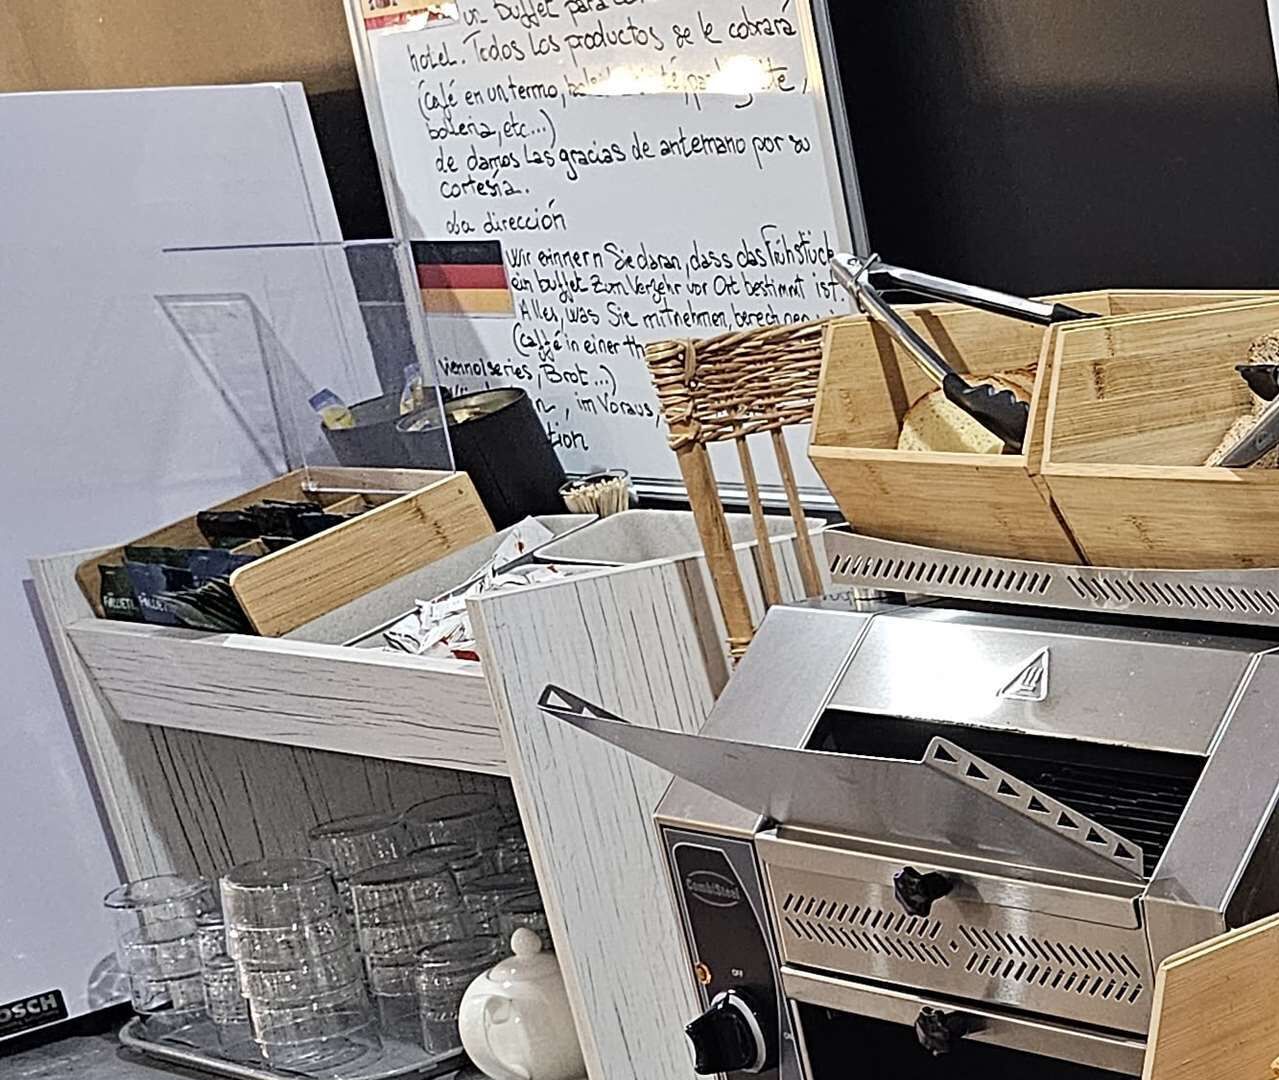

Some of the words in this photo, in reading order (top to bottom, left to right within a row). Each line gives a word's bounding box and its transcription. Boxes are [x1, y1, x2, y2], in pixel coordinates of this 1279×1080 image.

[564, 17, 664, 67] productos
[465, 88, 484, 105] en
[487, 87, 507, 104] un
[559, 140, 626, 181] gracias
[632, 131, 655, 160] de
[660, 126, 746, 158] antemano
[752, 135, 784, 170] por
[483, 199, 567, 233] dirección
[604, 242, 635, 272] Sie
[690, 240, 733, 271] dass
[511, 273, 533, 294] ein
[687, 281, 708, 296] vor
[713, 274, 740, 296] Ort
[565, 305, 600, 325] was
[607, 301, 639, 327] Sie
[564, 333, 579, 352] in
[583, 333, 620, 354] einer
[539, 363, 589, 386] Brot
[574, 393, 597, 415] im
[0, 993, 58, 1023] OSCH
